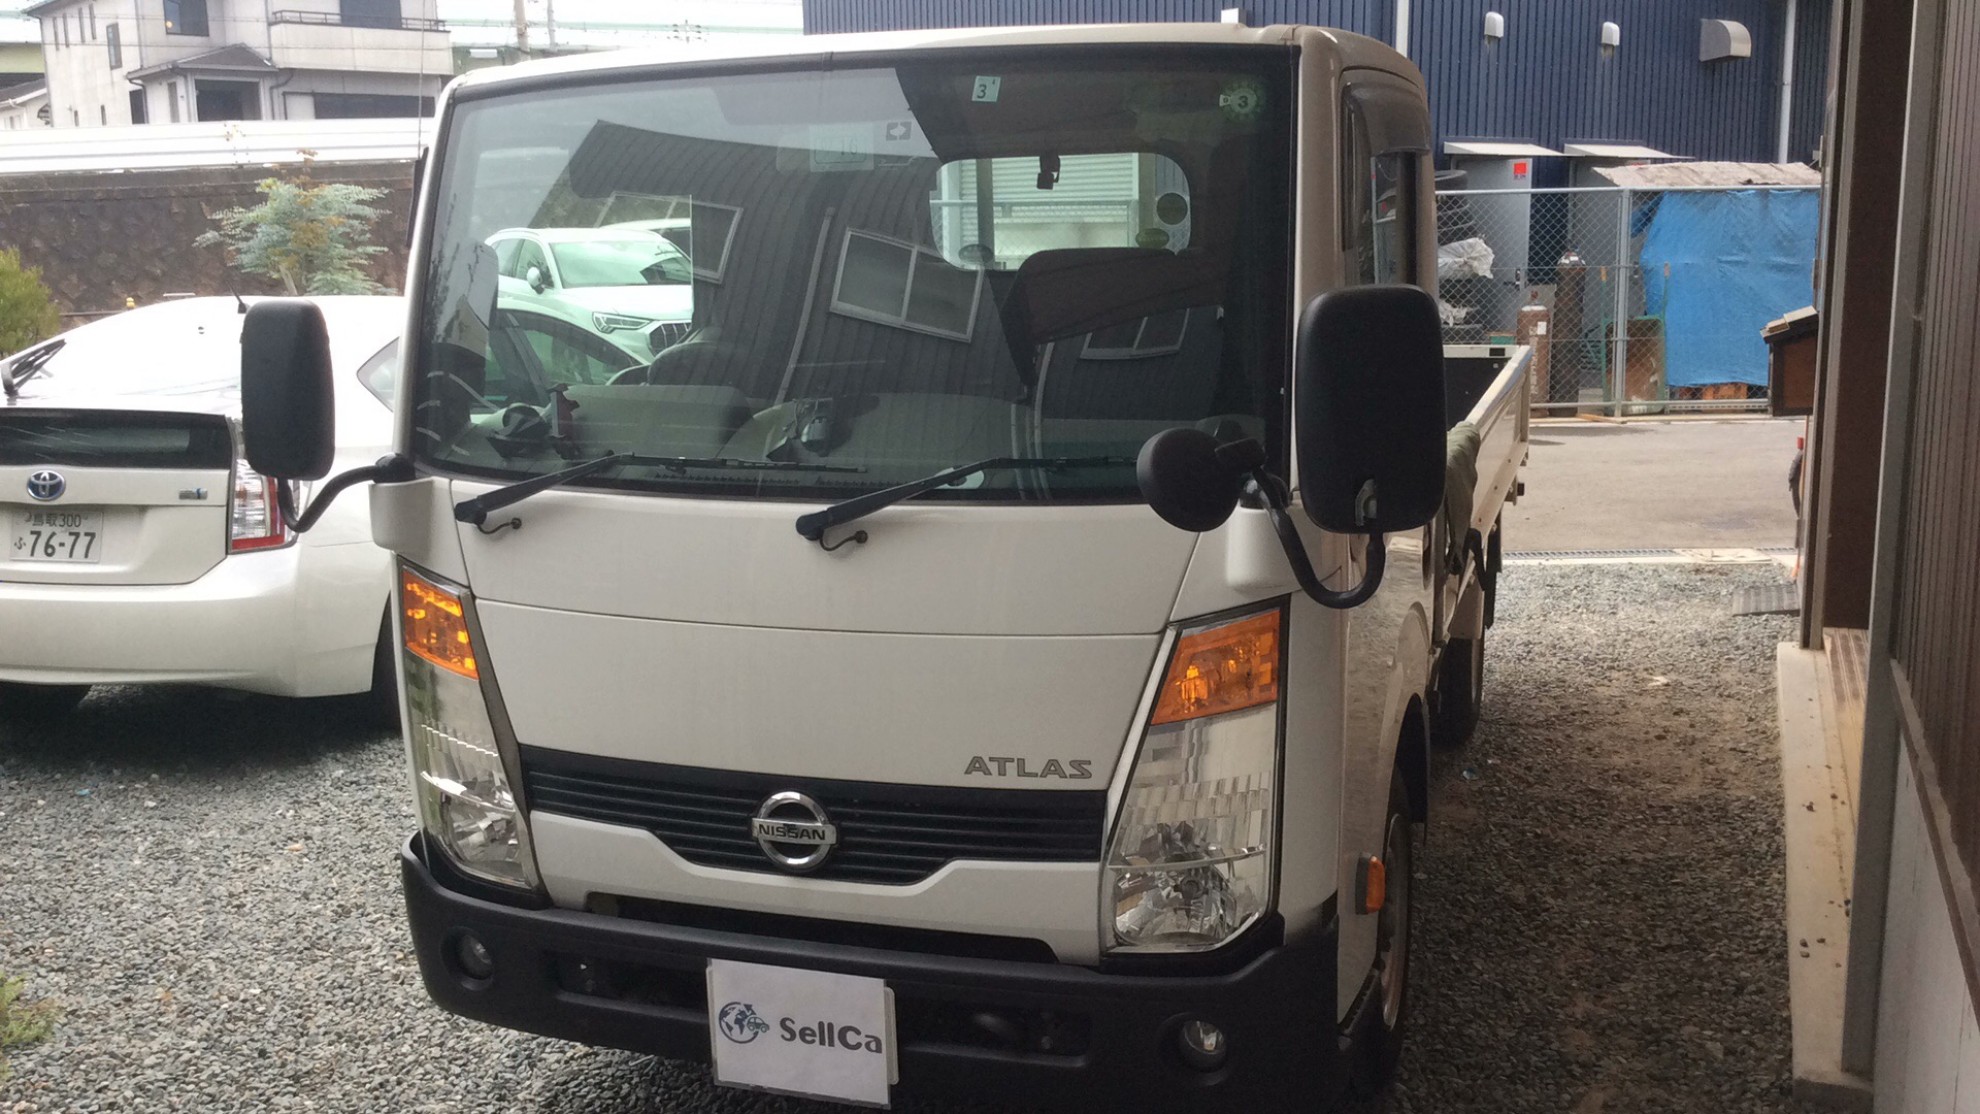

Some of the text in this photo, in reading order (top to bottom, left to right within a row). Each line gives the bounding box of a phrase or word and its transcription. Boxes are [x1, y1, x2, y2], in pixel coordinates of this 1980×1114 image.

[977, 83, 987, 99] 3
[1238, 95, 1249, 109] 3
[30, 530, 96, 558] 76-77
[964, 756, 1092, 779] ATLAS
[758, 824, 825, 840] NISSAN
[779, 1017, 883, 1054] SellCa
